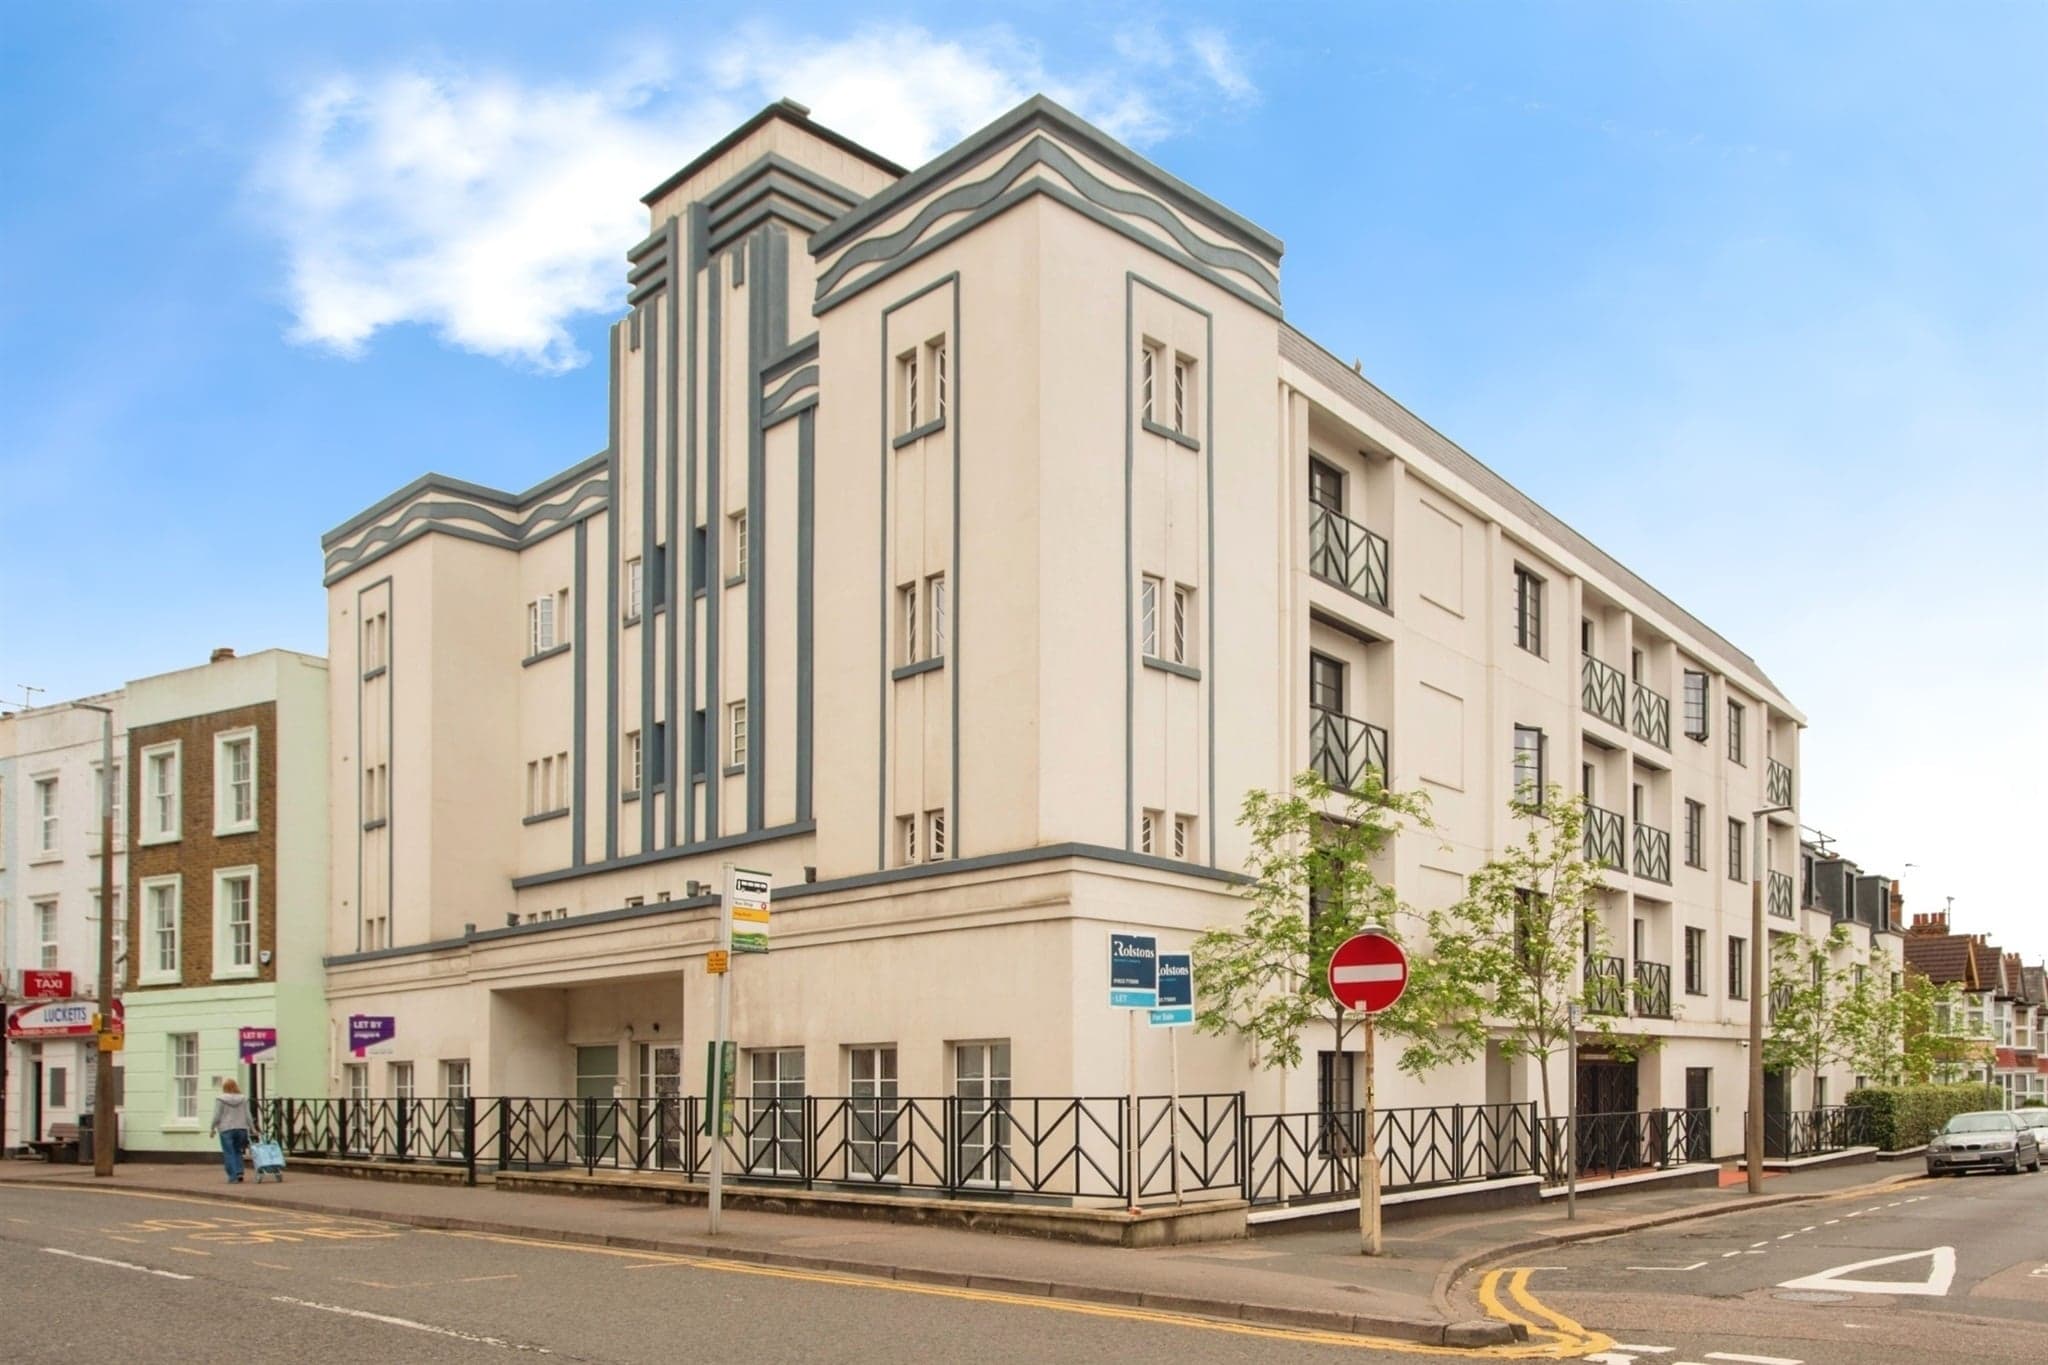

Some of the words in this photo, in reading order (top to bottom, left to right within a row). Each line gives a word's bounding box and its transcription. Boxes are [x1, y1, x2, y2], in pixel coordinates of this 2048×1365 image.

[1114, 941, 1155, 958] Rolstons
[34, 979, 63, 988] TAXI
[44, 1007, 87, 1022] LUCKETTS
[353, 1020, 368, 1029] LET
[243, 1031, 255, 1040] LET
